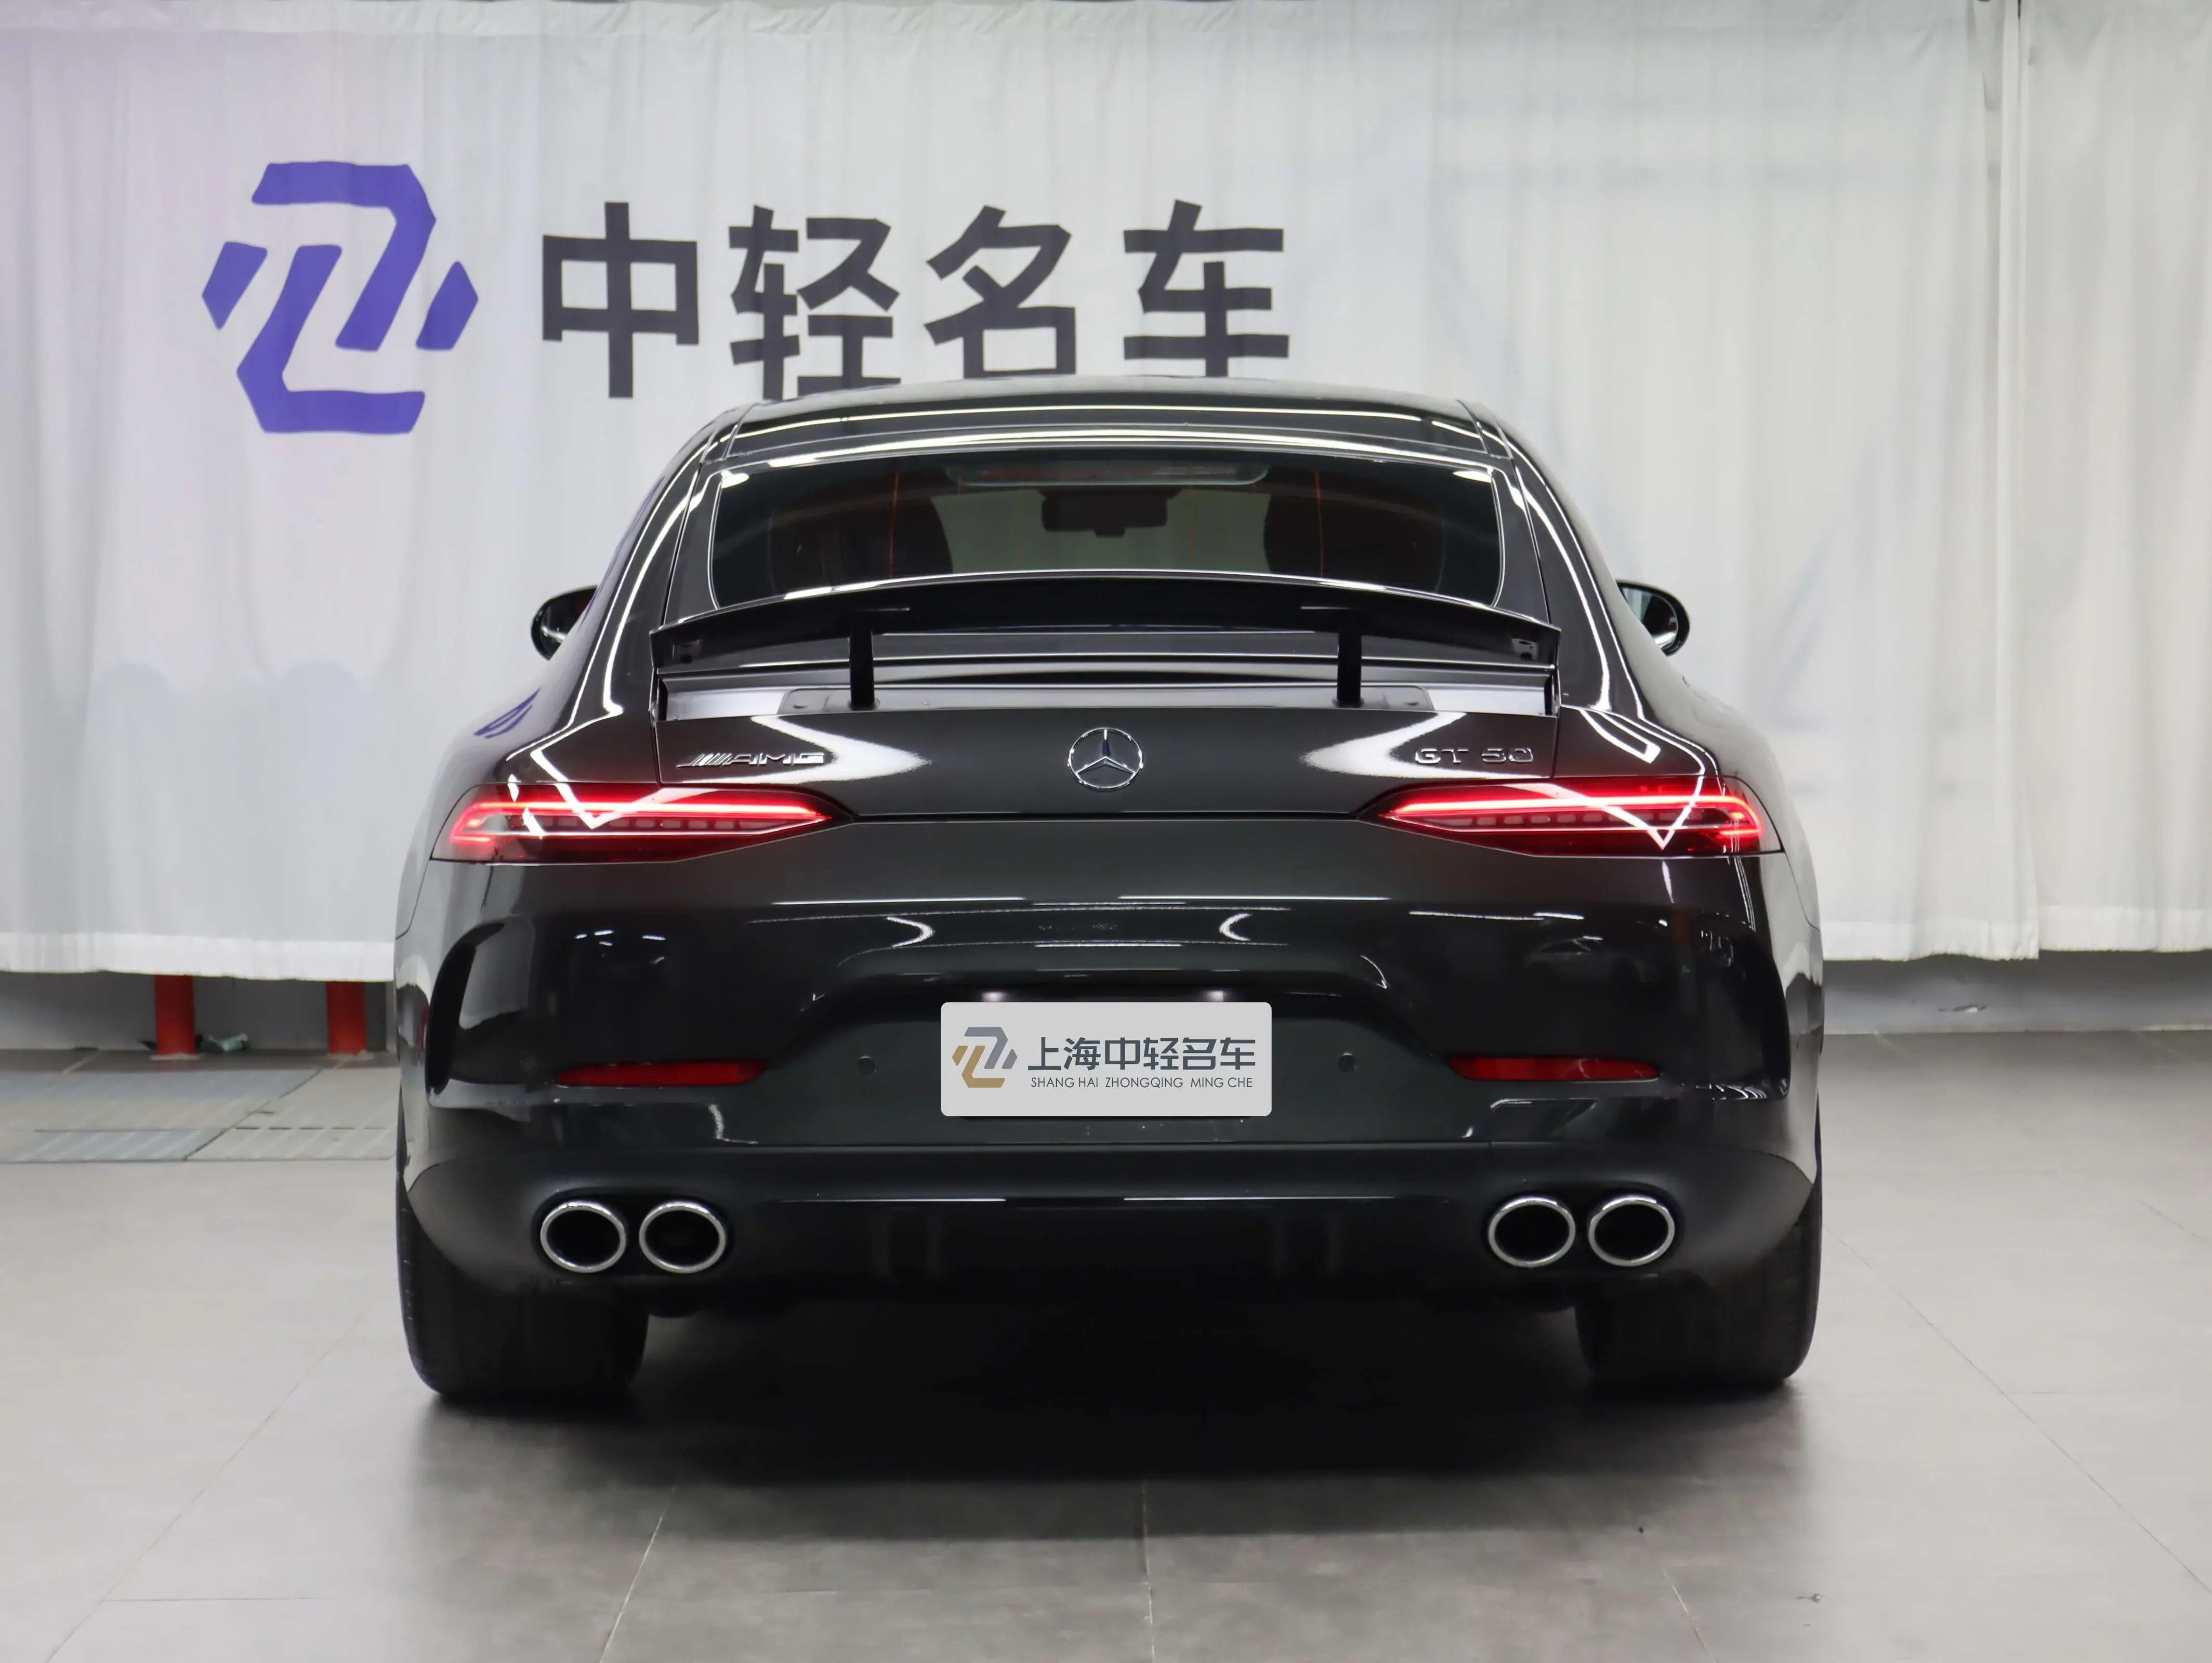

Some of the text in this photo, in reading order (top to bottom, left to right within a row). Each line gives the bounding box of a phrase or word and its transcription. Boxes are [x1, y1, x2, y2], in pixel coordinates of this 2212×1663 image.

[542, 201, 1289, 400] 中轻名车
[721, 753, 824, 767] AMG
[1415, 747, 1534, 764] GT 50
[1028, 1037, 1256, 1071] 上海中轻名车
[1031, 1077, 1253, 1088] SHANG HAI ZHONGQING MING CHE
